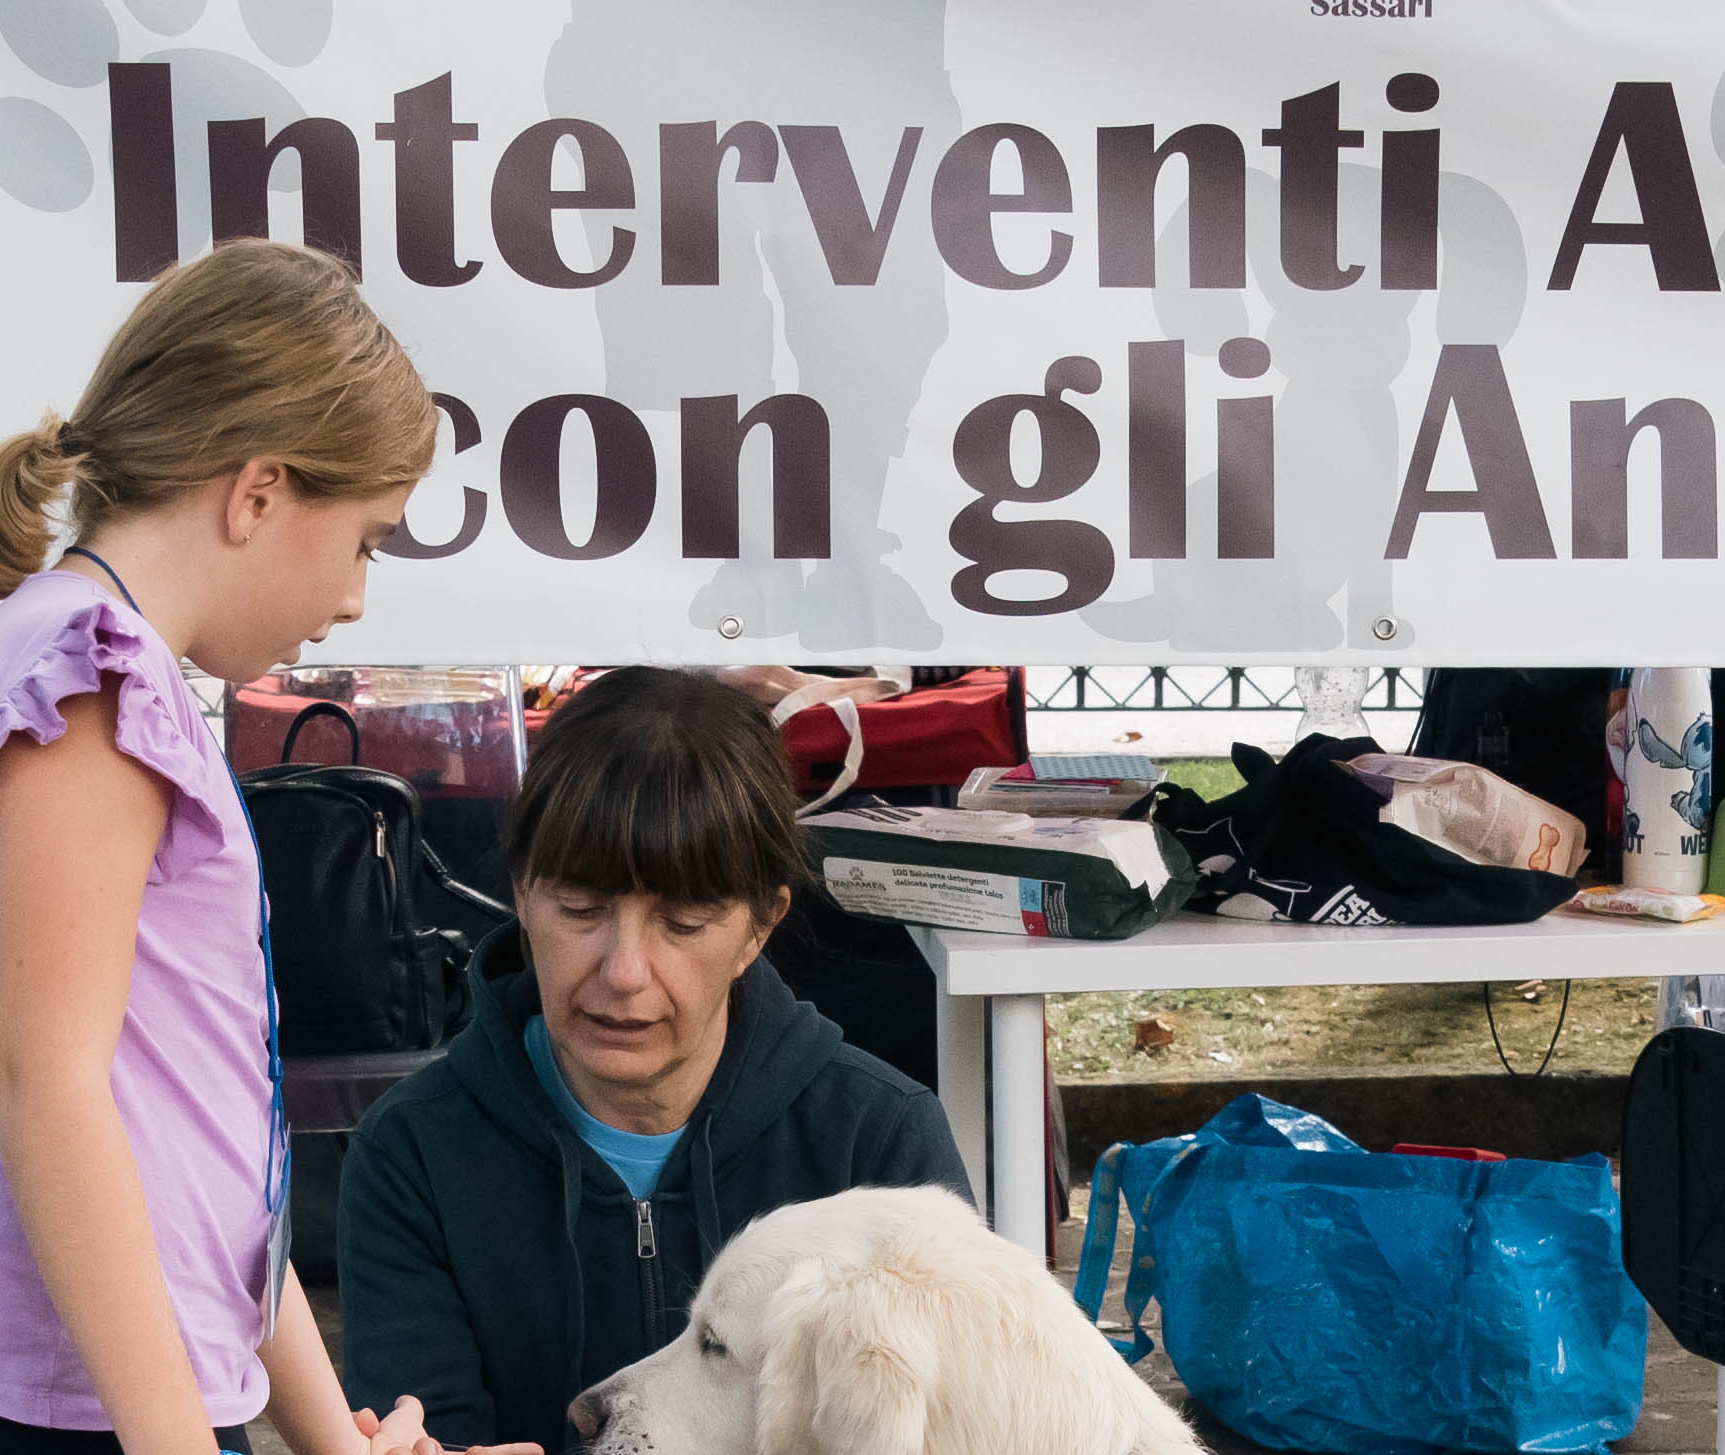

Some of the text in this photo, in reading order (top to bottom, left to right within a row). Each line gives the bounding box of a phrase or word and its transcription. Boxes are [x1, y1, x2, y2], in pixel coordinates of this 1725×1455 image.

[1310, 0, 1433, 18] Sassari
[108, 62, 1440, 292] Interventi
[375, 390, 830, 561] con
[950, 337, 1276, 617] gli
